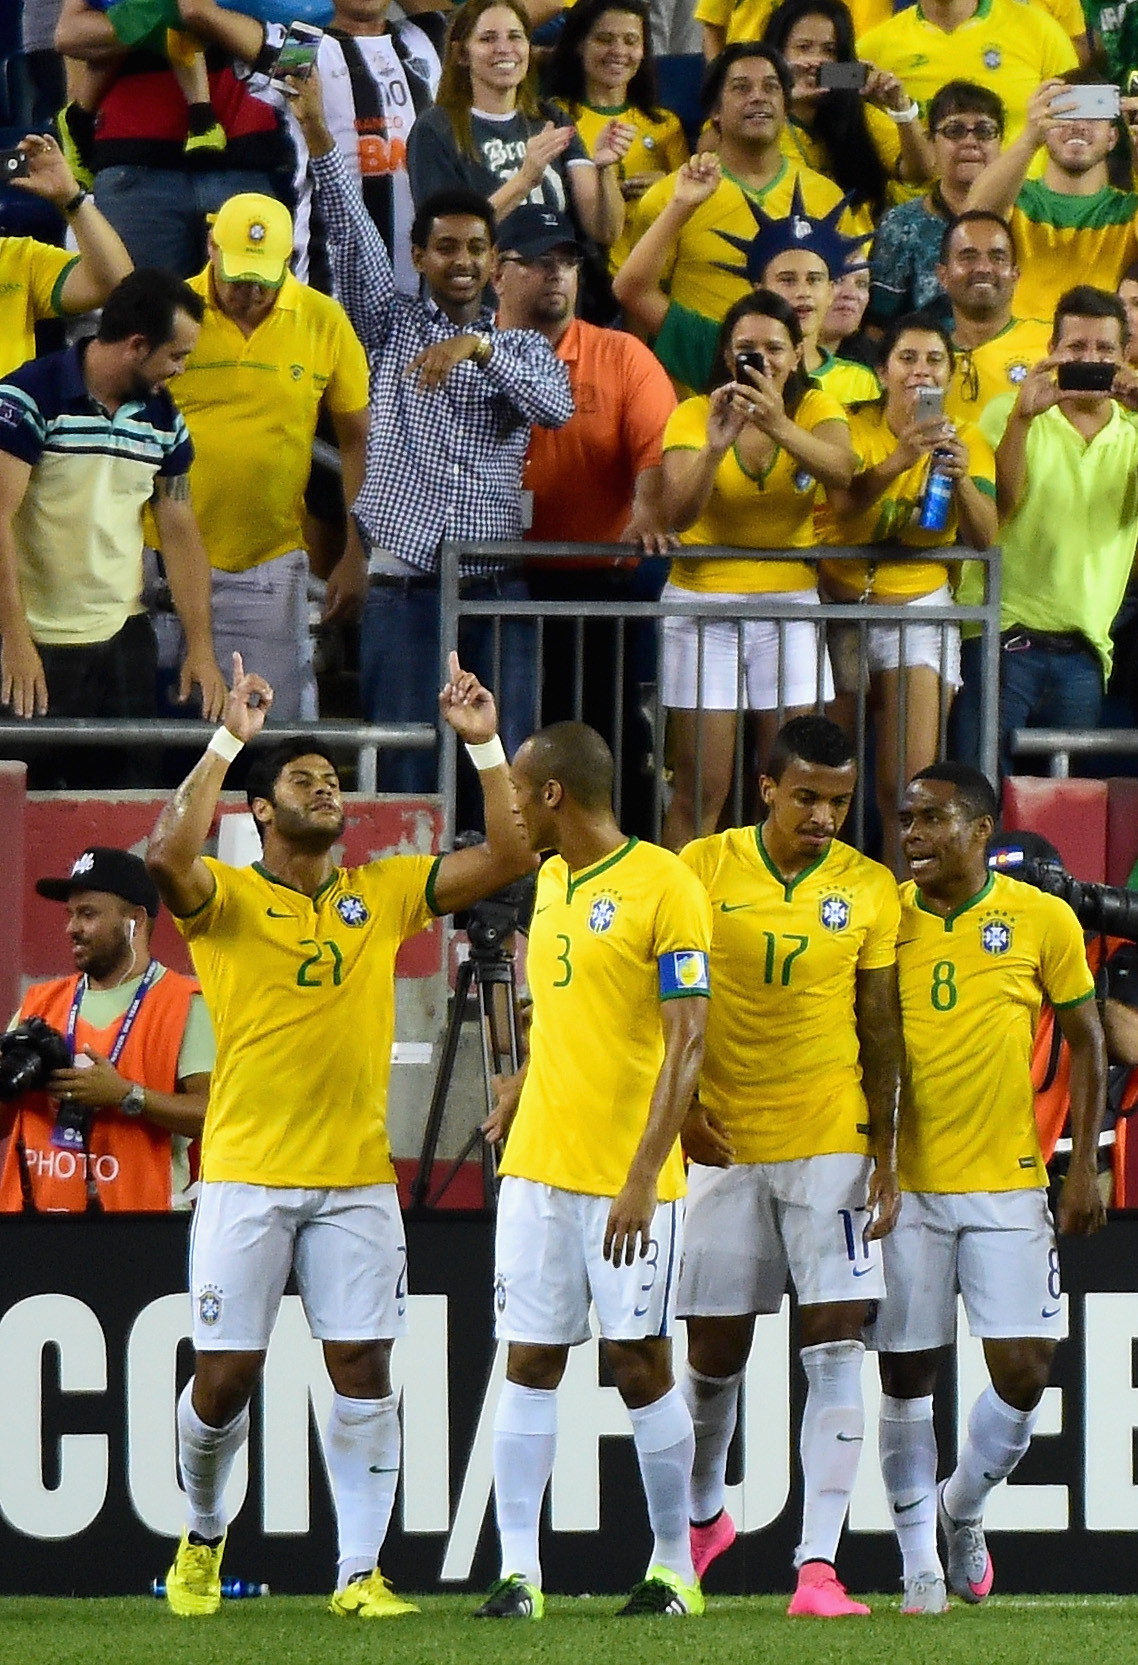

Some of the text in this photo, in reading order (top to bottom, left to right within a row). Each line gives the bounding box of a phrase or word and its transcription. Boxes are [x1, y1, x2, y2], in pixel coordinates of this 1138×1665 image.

[296, 939, 344, 987] 21
[553, 933, 574, 988] 3
[762, 930, 810, 987] 17
[930, 960, 957, 1012] 8
[25, 1148, 120, 1182] PHOTO
[1046, 1247, 1062, 1300] 8
